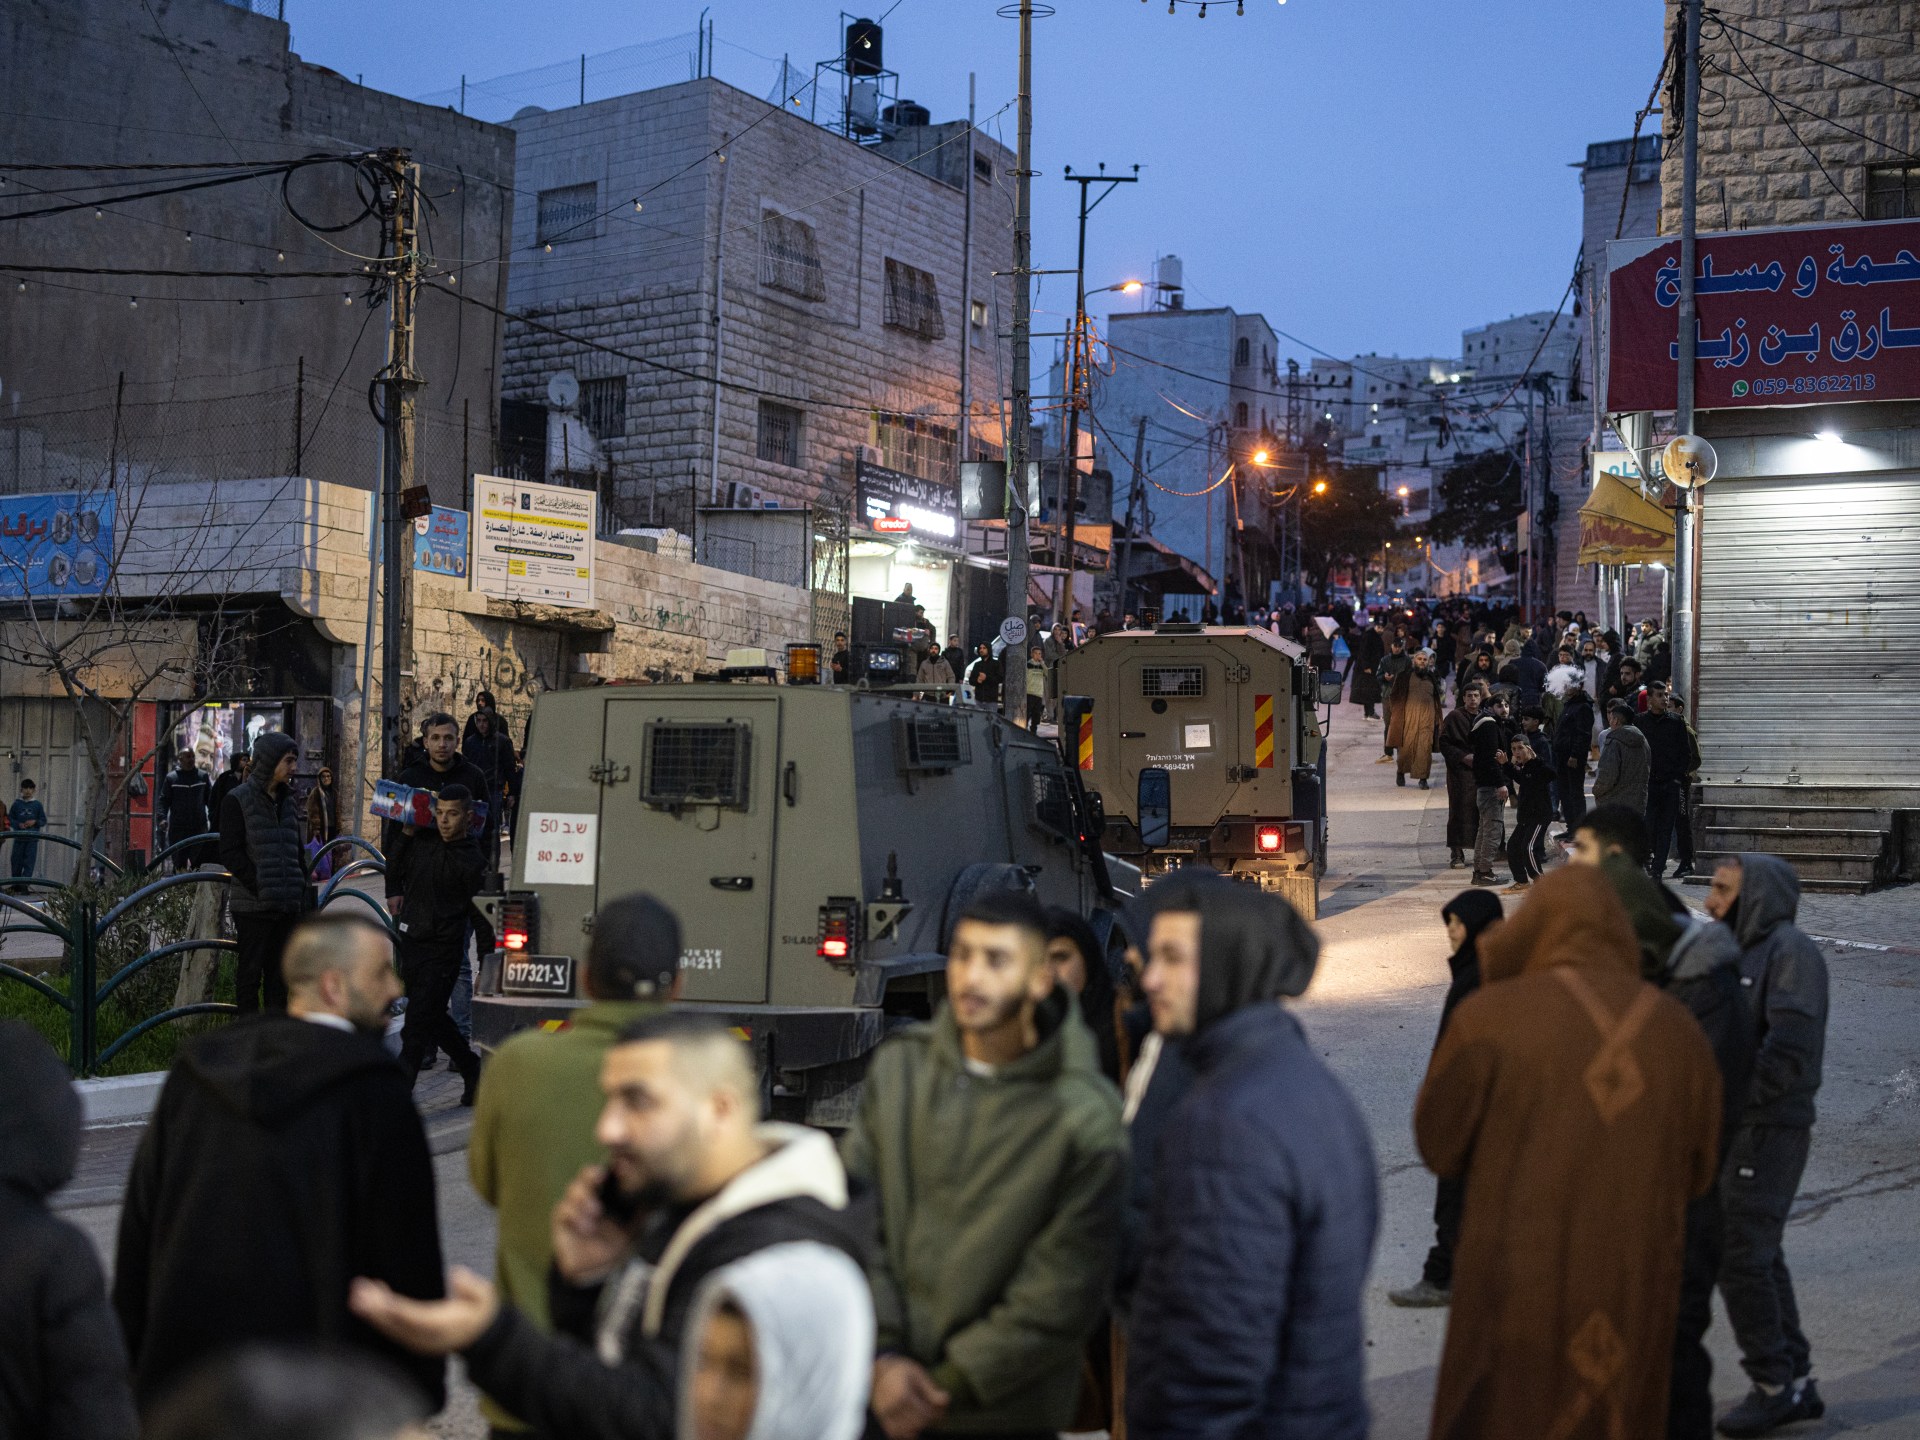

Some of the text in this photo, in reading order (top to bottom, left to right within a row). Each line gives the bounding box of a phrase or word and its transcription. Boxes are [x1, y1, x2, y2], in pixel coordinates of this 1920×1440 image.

[1655, 253, 1787, 308] مسلخ
[1792, 255, 1818, 298] و
[1759, 321, 1821, 366] بن
[1752, 374, 1876, 395] 059-8362213
[540, 819, 558, 833] 50
[538, 850, 552, 862] 80
